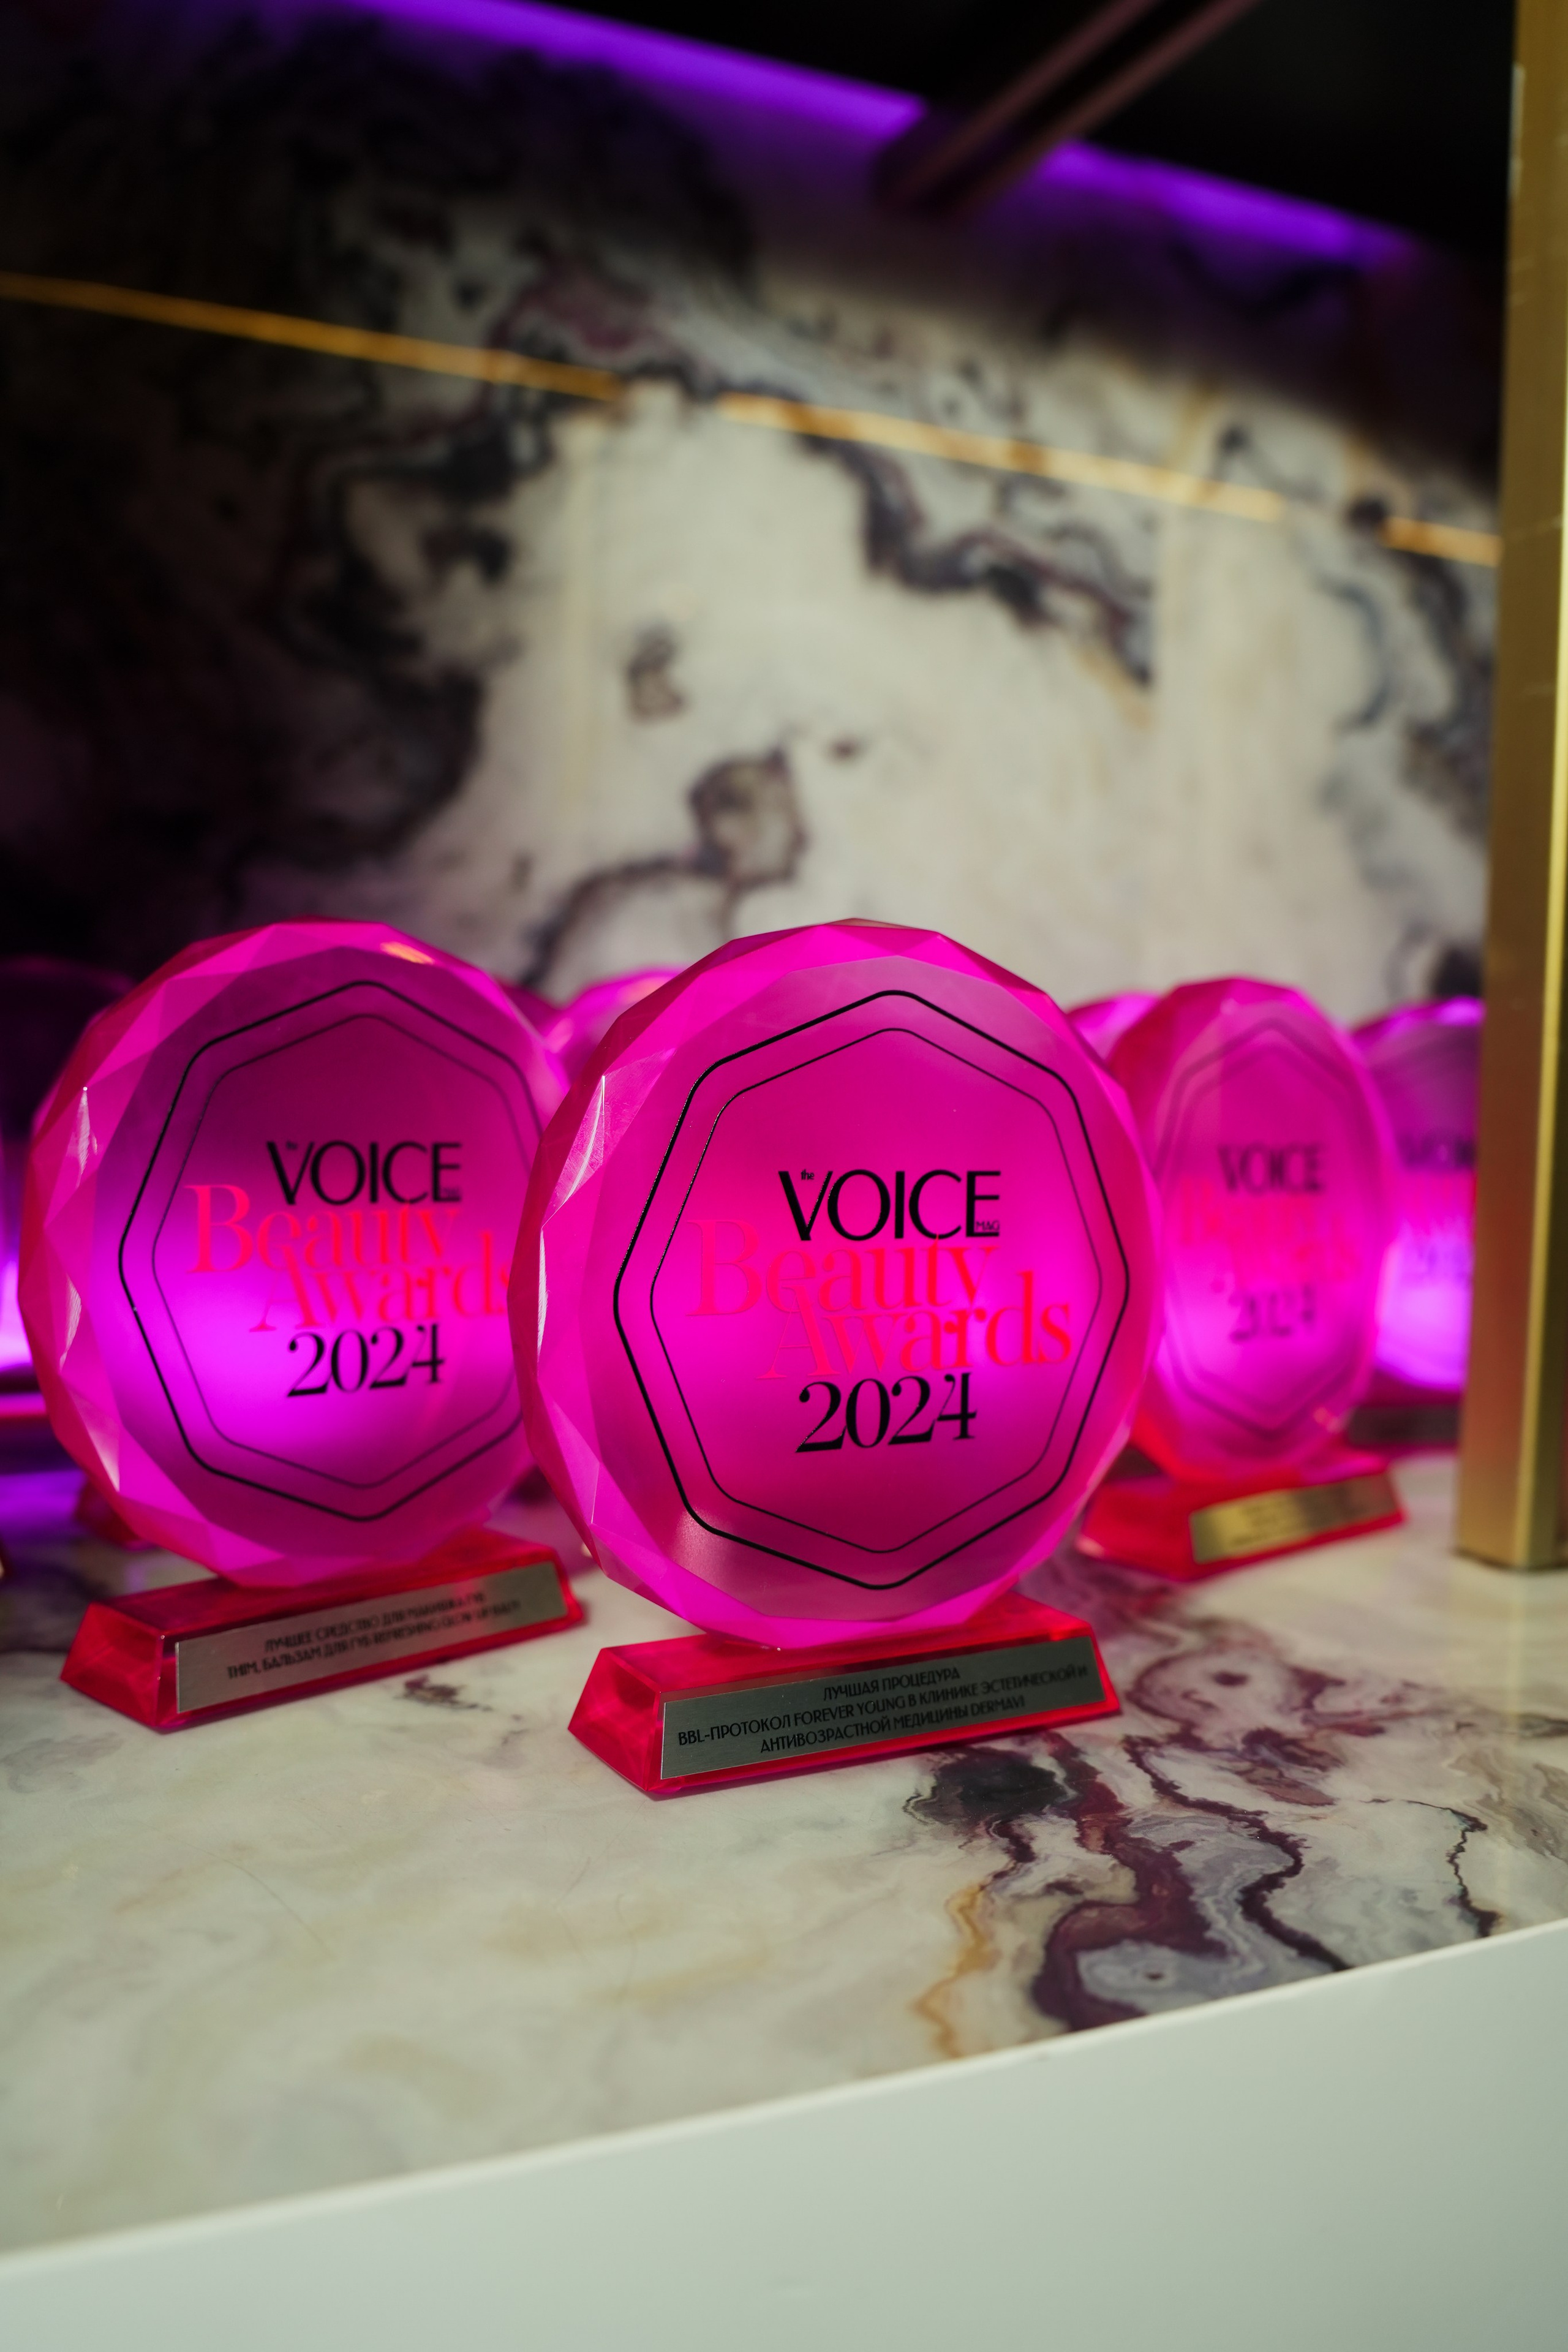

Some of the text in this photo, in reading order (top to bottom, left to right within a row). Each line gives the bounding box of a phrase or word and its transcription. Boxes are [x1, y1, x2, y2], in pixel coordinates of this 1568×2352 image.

[266, 1140, 462, 1205] VOICE
[801, 1169, 815, 1180] the
[1218, 1141, 1327, 1196] VOICE
[185, 1184, 461, 1273] Beauty
[778, 1169, 1001, 1241] VOICE
[976, 1220, 1000, 1231] MAG
[686, 1219, 1001, 1316] Beauty
[755, 1269, 1072, 1379] Awards
[286, 1324, 445, 1397] 2024
[795, 1372, 978, 1453] 2024
[262, 1645, 322, 1672] БАЛЬЗАМ
[823, 1667, 960, 1702] ЛУЧШАЯ ПРОЦЕДУРА
[678, 1714, 791, 1746] BBL-ПРОТОКОЛ
[794, 1704, 854, 1727] FOREVER
[856, 1695, 906, 1715] YOUNG
[919, 1683, 979, 1705] КЛИНИКЕ
[760, 1694, 1026, 1753] АНТИВОЗРАСТНОЙ МЕДИЦИНЫ DERMAVI
